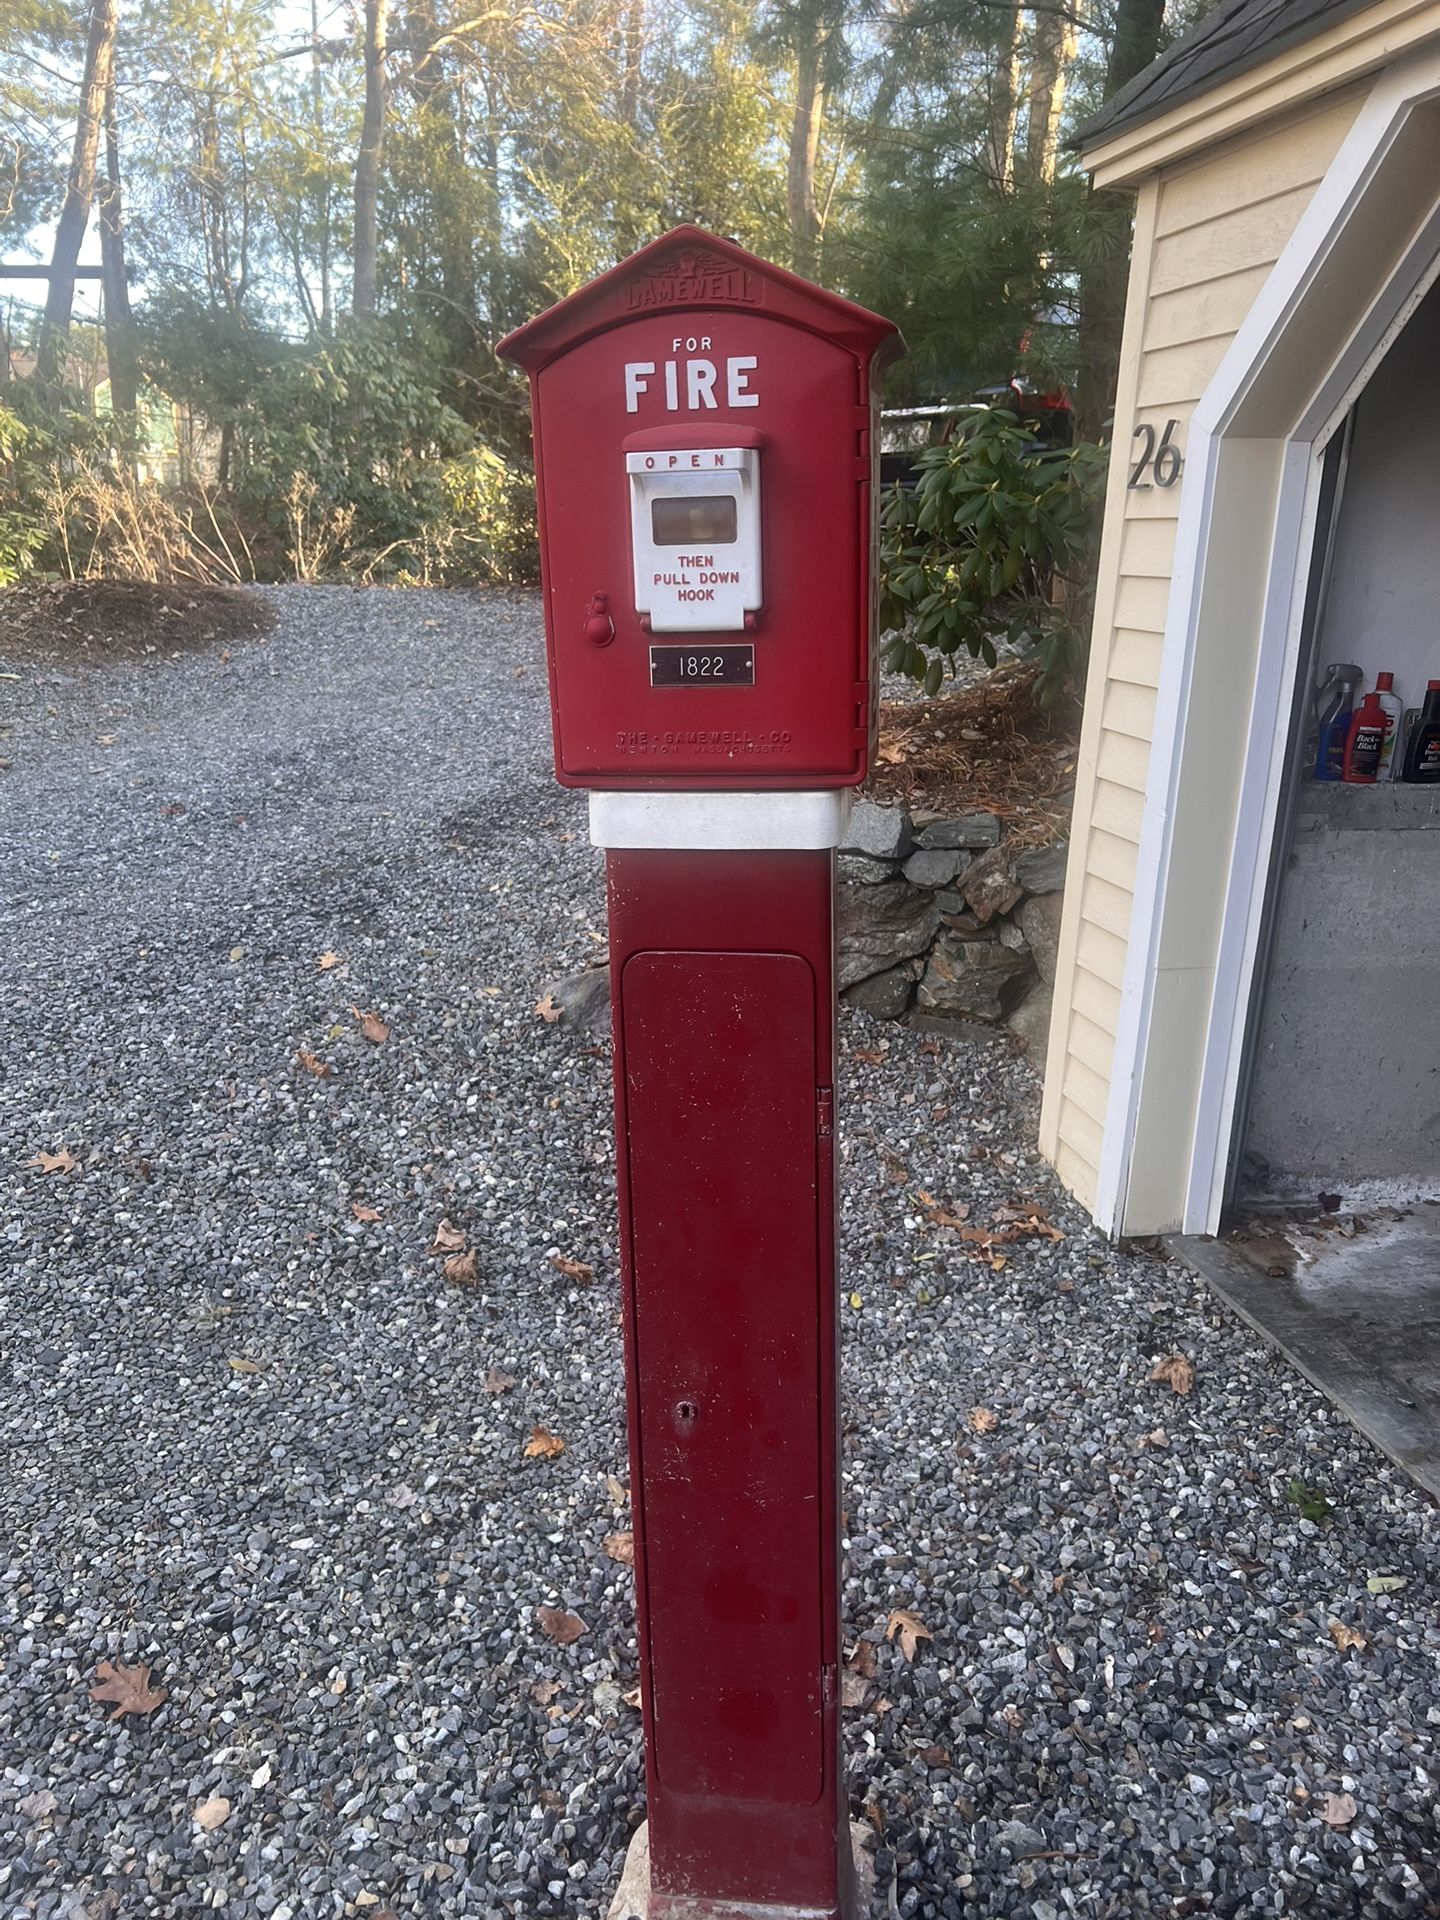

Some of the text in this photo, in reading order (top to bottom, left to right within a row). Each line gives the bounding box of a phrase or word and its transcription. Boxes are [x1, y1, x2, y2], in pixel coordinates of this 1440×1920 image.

[626, 269, 757, 311] GAMEWELL
[672, 336, 712, 352] FOR
[625, 356, 759, 412] FIRE
[645, 454, 724, 469] OPEN
[1127, 419, 1181, 490] 26
[677, 555, 714, 568] THEN
[654, 571, 740, 586] PULL DOWN
[677, 589, 715, 602] HOOK
[680, 656, 724, 676] 1822
[616, 730, 793, 745] THE GAMEWELL CO
[1357, 742, 1377, 750] Black
